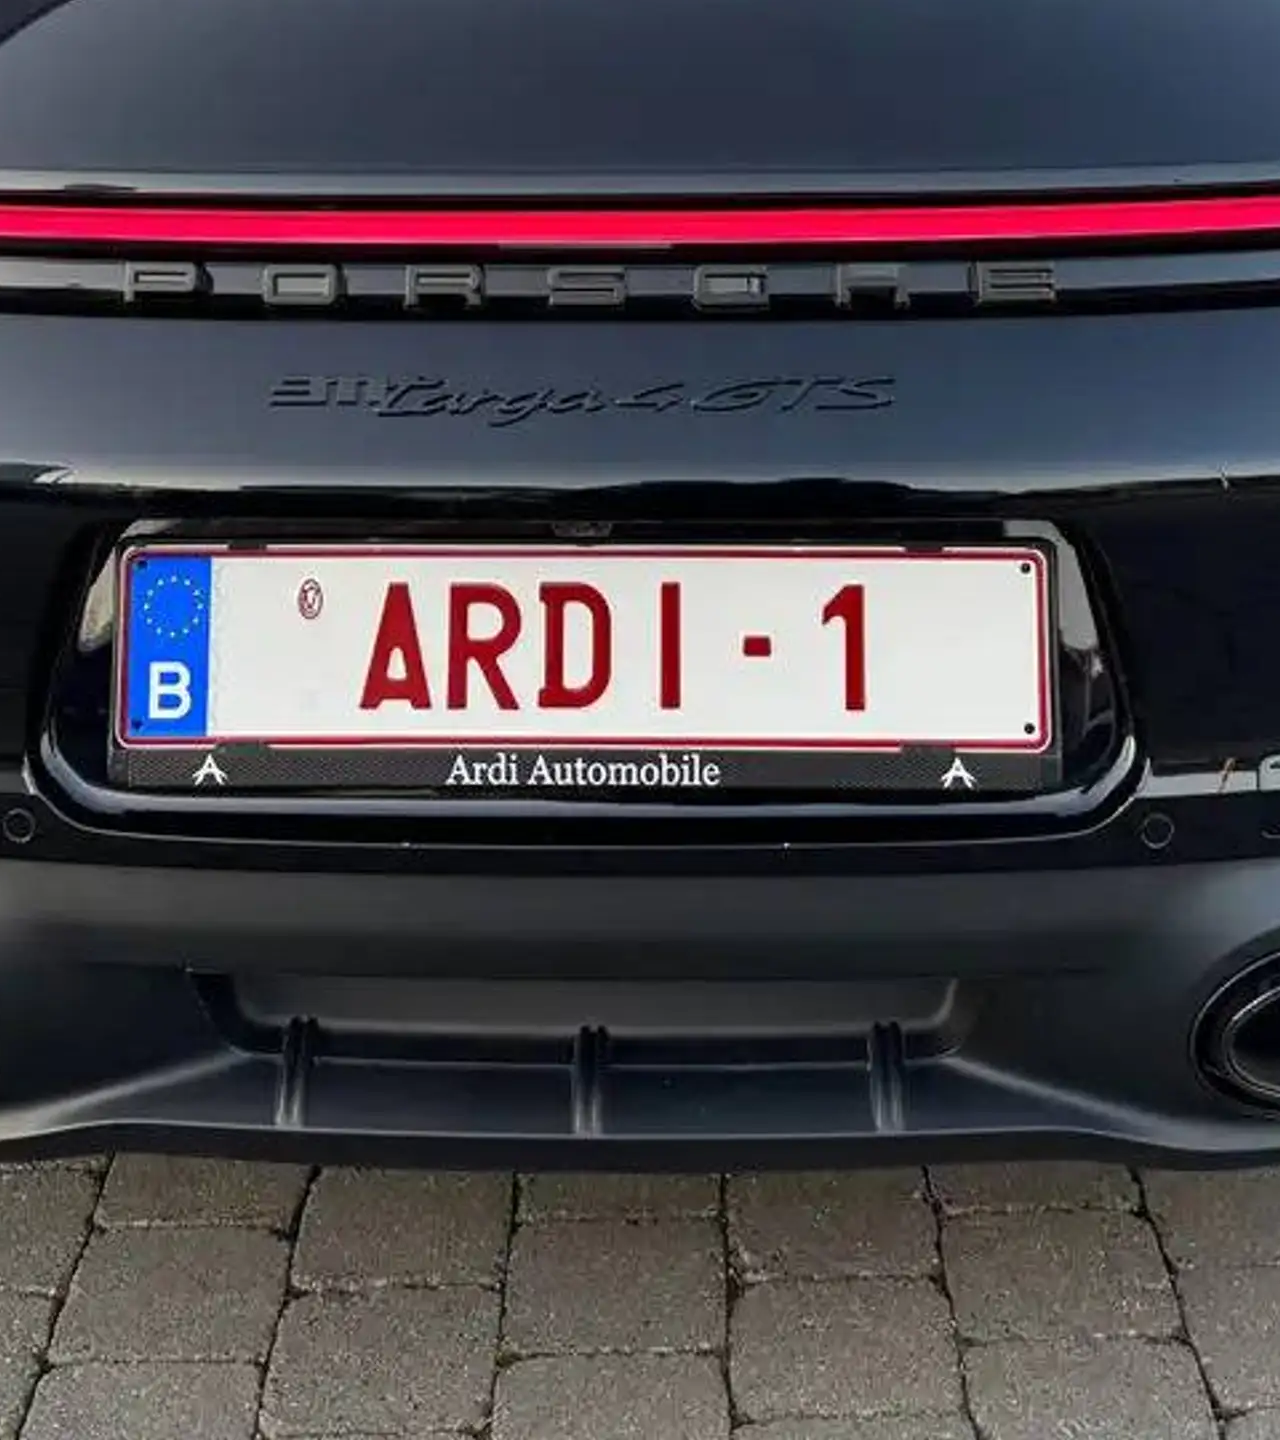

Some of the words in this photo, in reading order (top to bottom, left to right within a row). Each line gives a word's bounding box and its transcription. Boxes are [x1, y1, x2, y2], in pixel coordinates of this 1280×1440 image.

[122, 259, 1058, 310] PORSCHE
[688, 374, 898, 410] GTS
[147, 660, 192, 720] B
[445, 752, 520, 786] Ardi
[527, 752, 721, 786] Automobile
